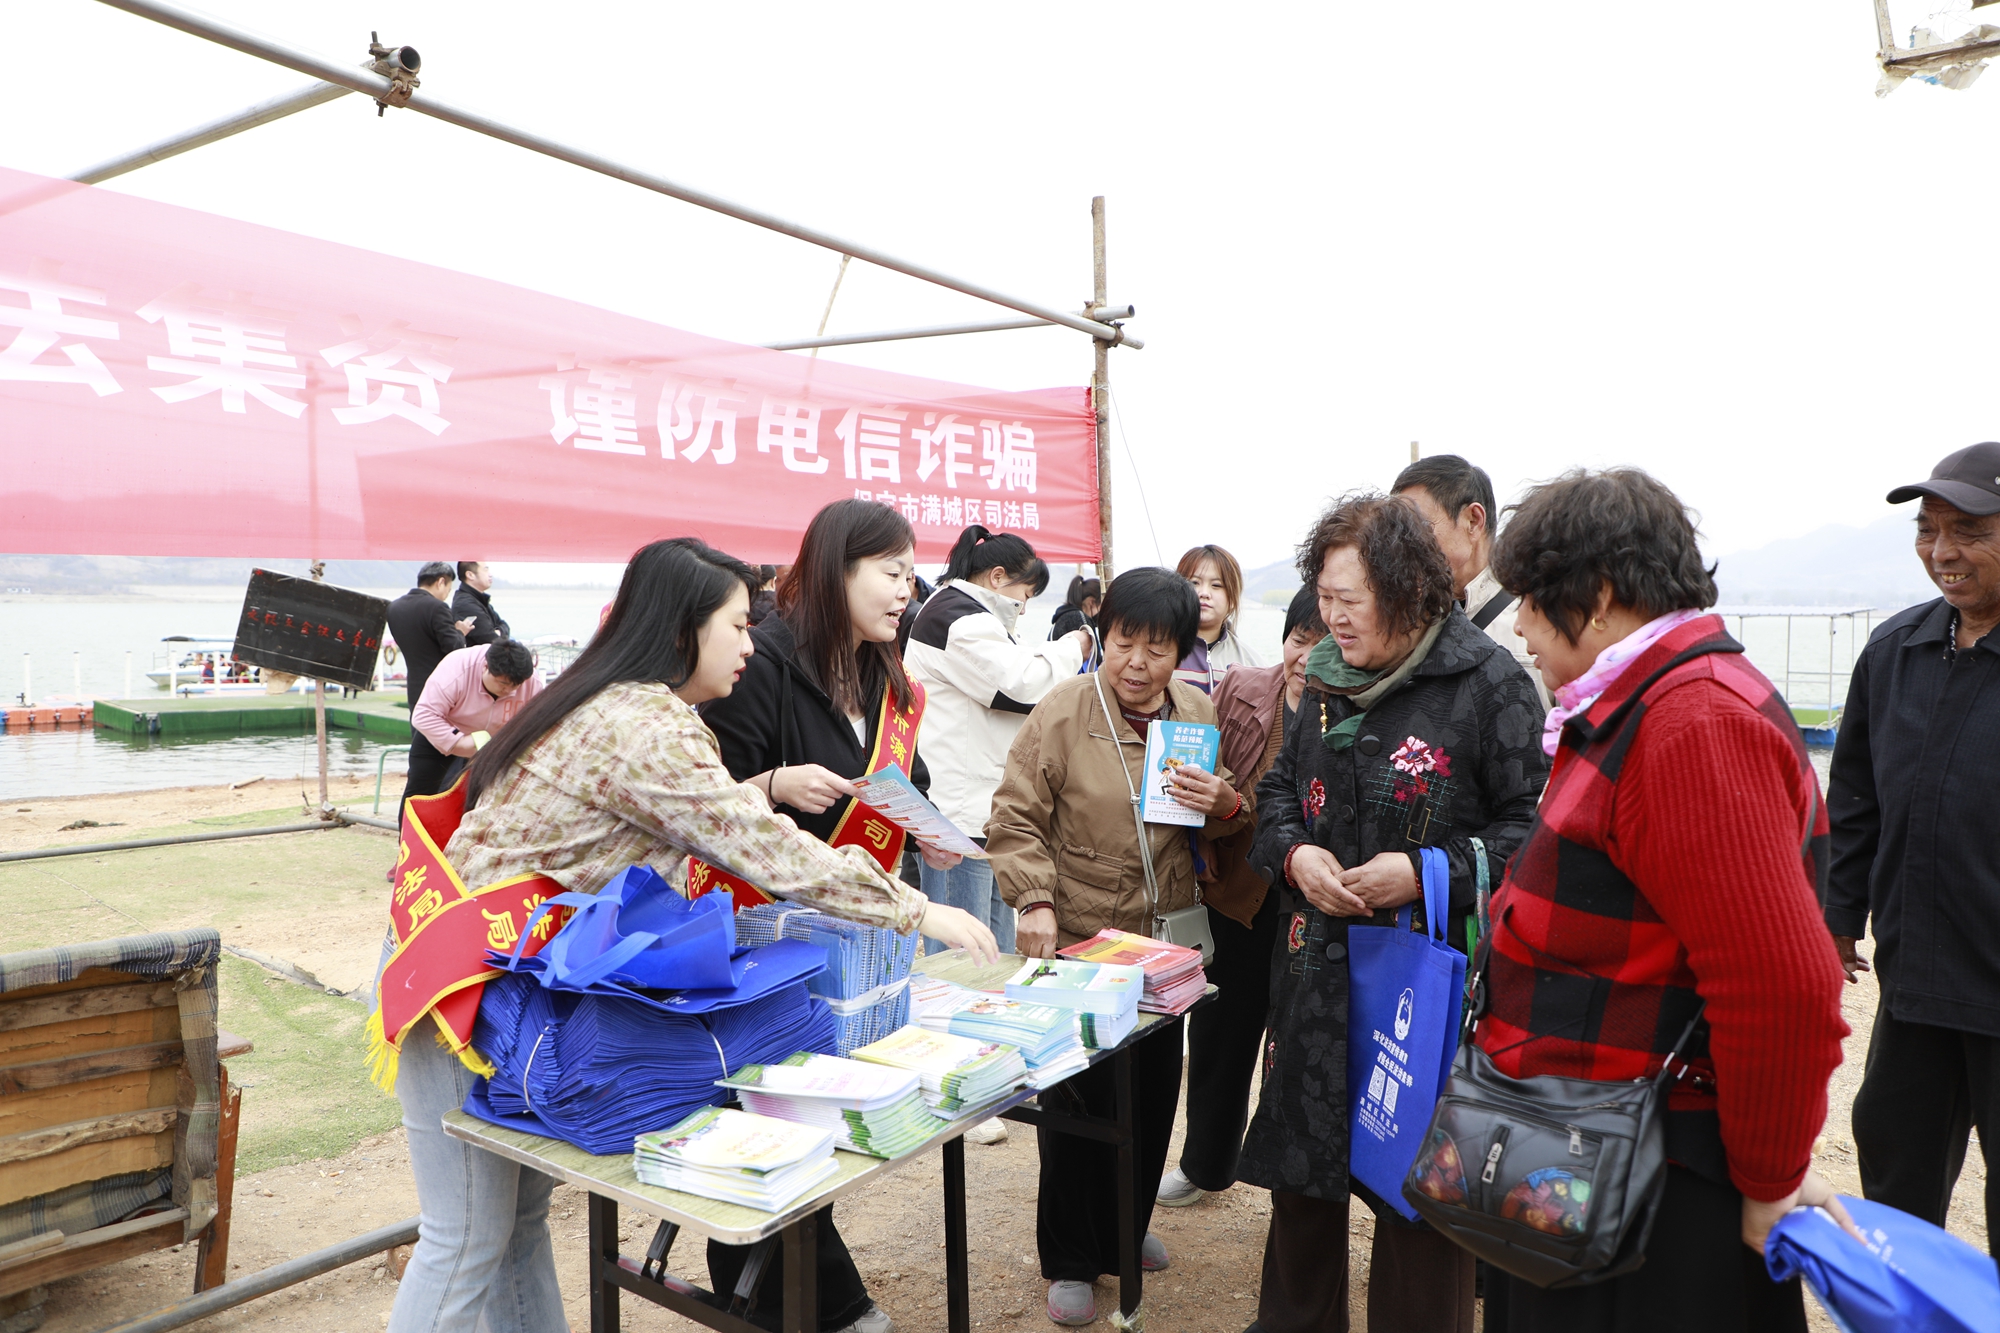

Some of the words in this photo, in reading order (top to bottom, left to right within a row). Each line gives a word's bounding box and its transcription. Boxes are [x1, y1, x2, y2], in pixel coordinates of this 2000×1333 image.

[538, 352, 1038, 494] 谨防电信诈骗
[863, 819, 893, 850] 司
